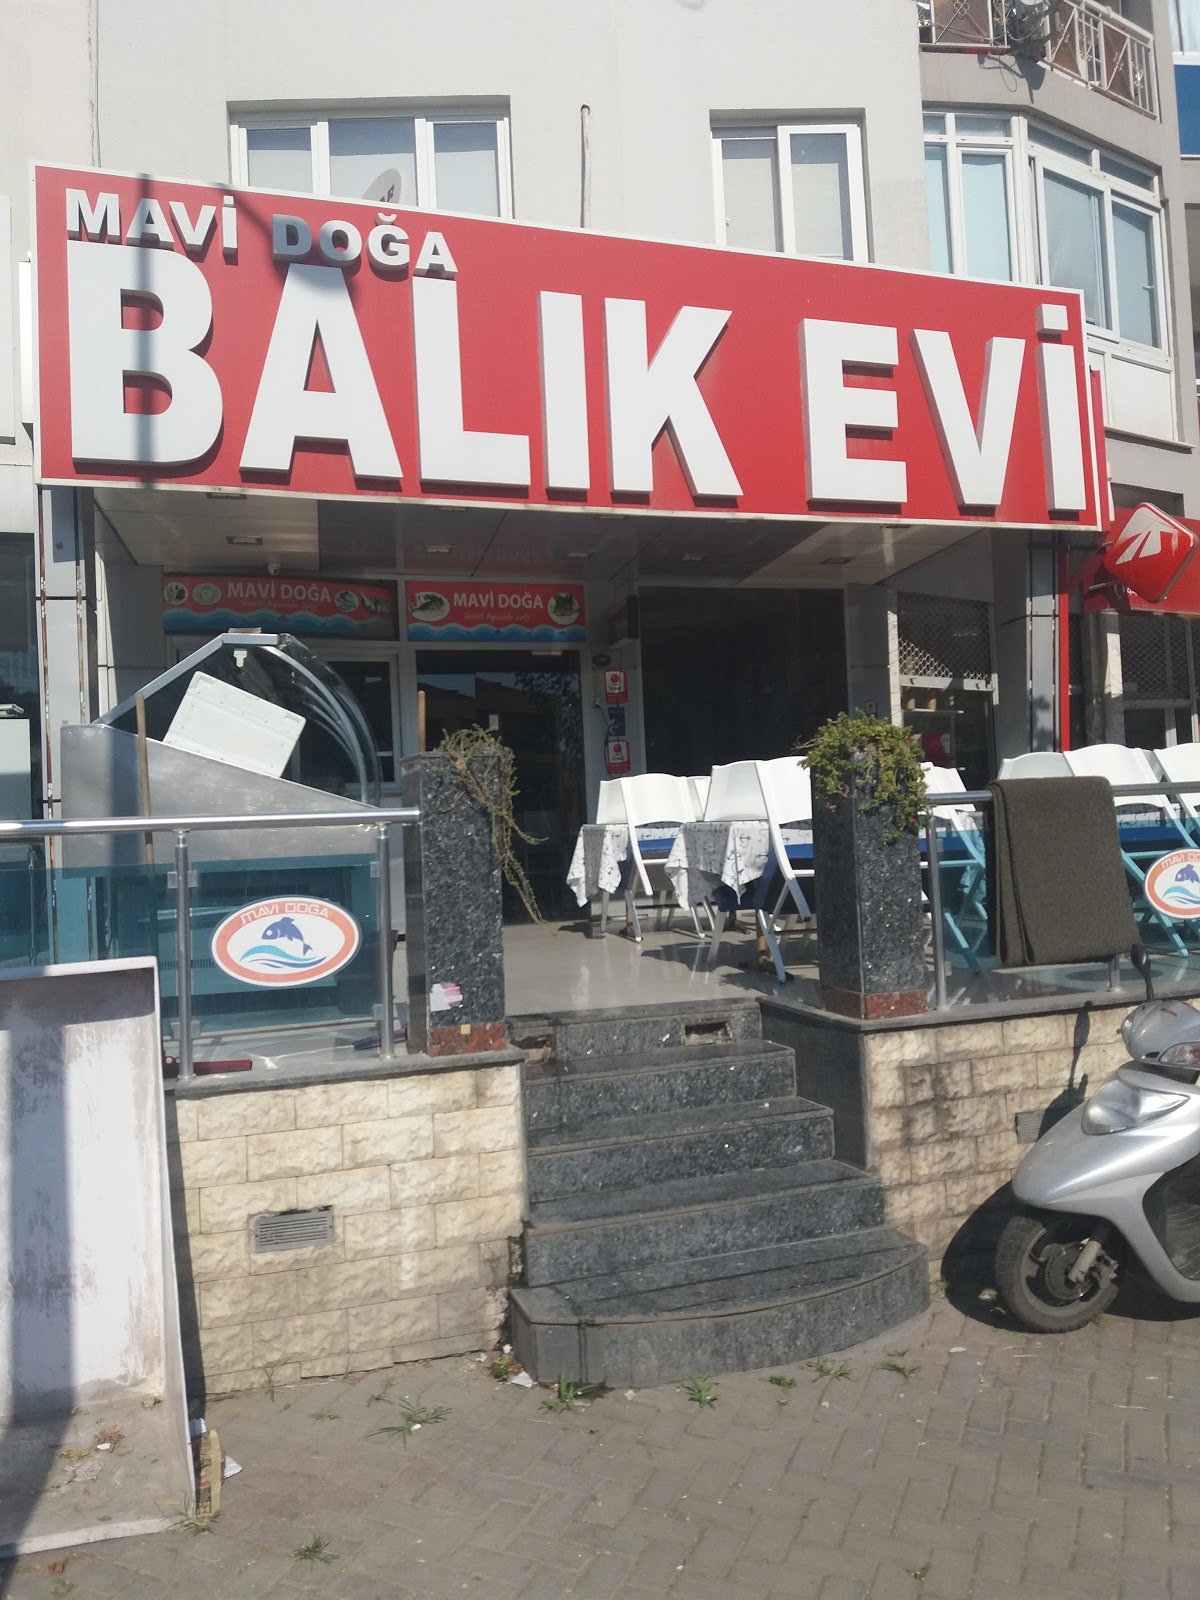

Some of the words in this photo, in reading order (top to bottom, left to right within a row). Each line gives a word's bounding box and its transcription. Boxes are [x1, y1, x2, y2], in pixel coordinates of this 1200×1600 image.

[66, 187, 237, 253] MAVİ
[272, 212, 459, 279] DOĞA
[66, 239, 743, 498] BALIK
[801, 303, 1087, 511] EVİ
[227, 580, 276, 599] MAVİ
[280, 583, 331, 603] DOĞA
[453, 590, 495, 608] MAVİ
[498, 591, 544, 609] DOĞA
